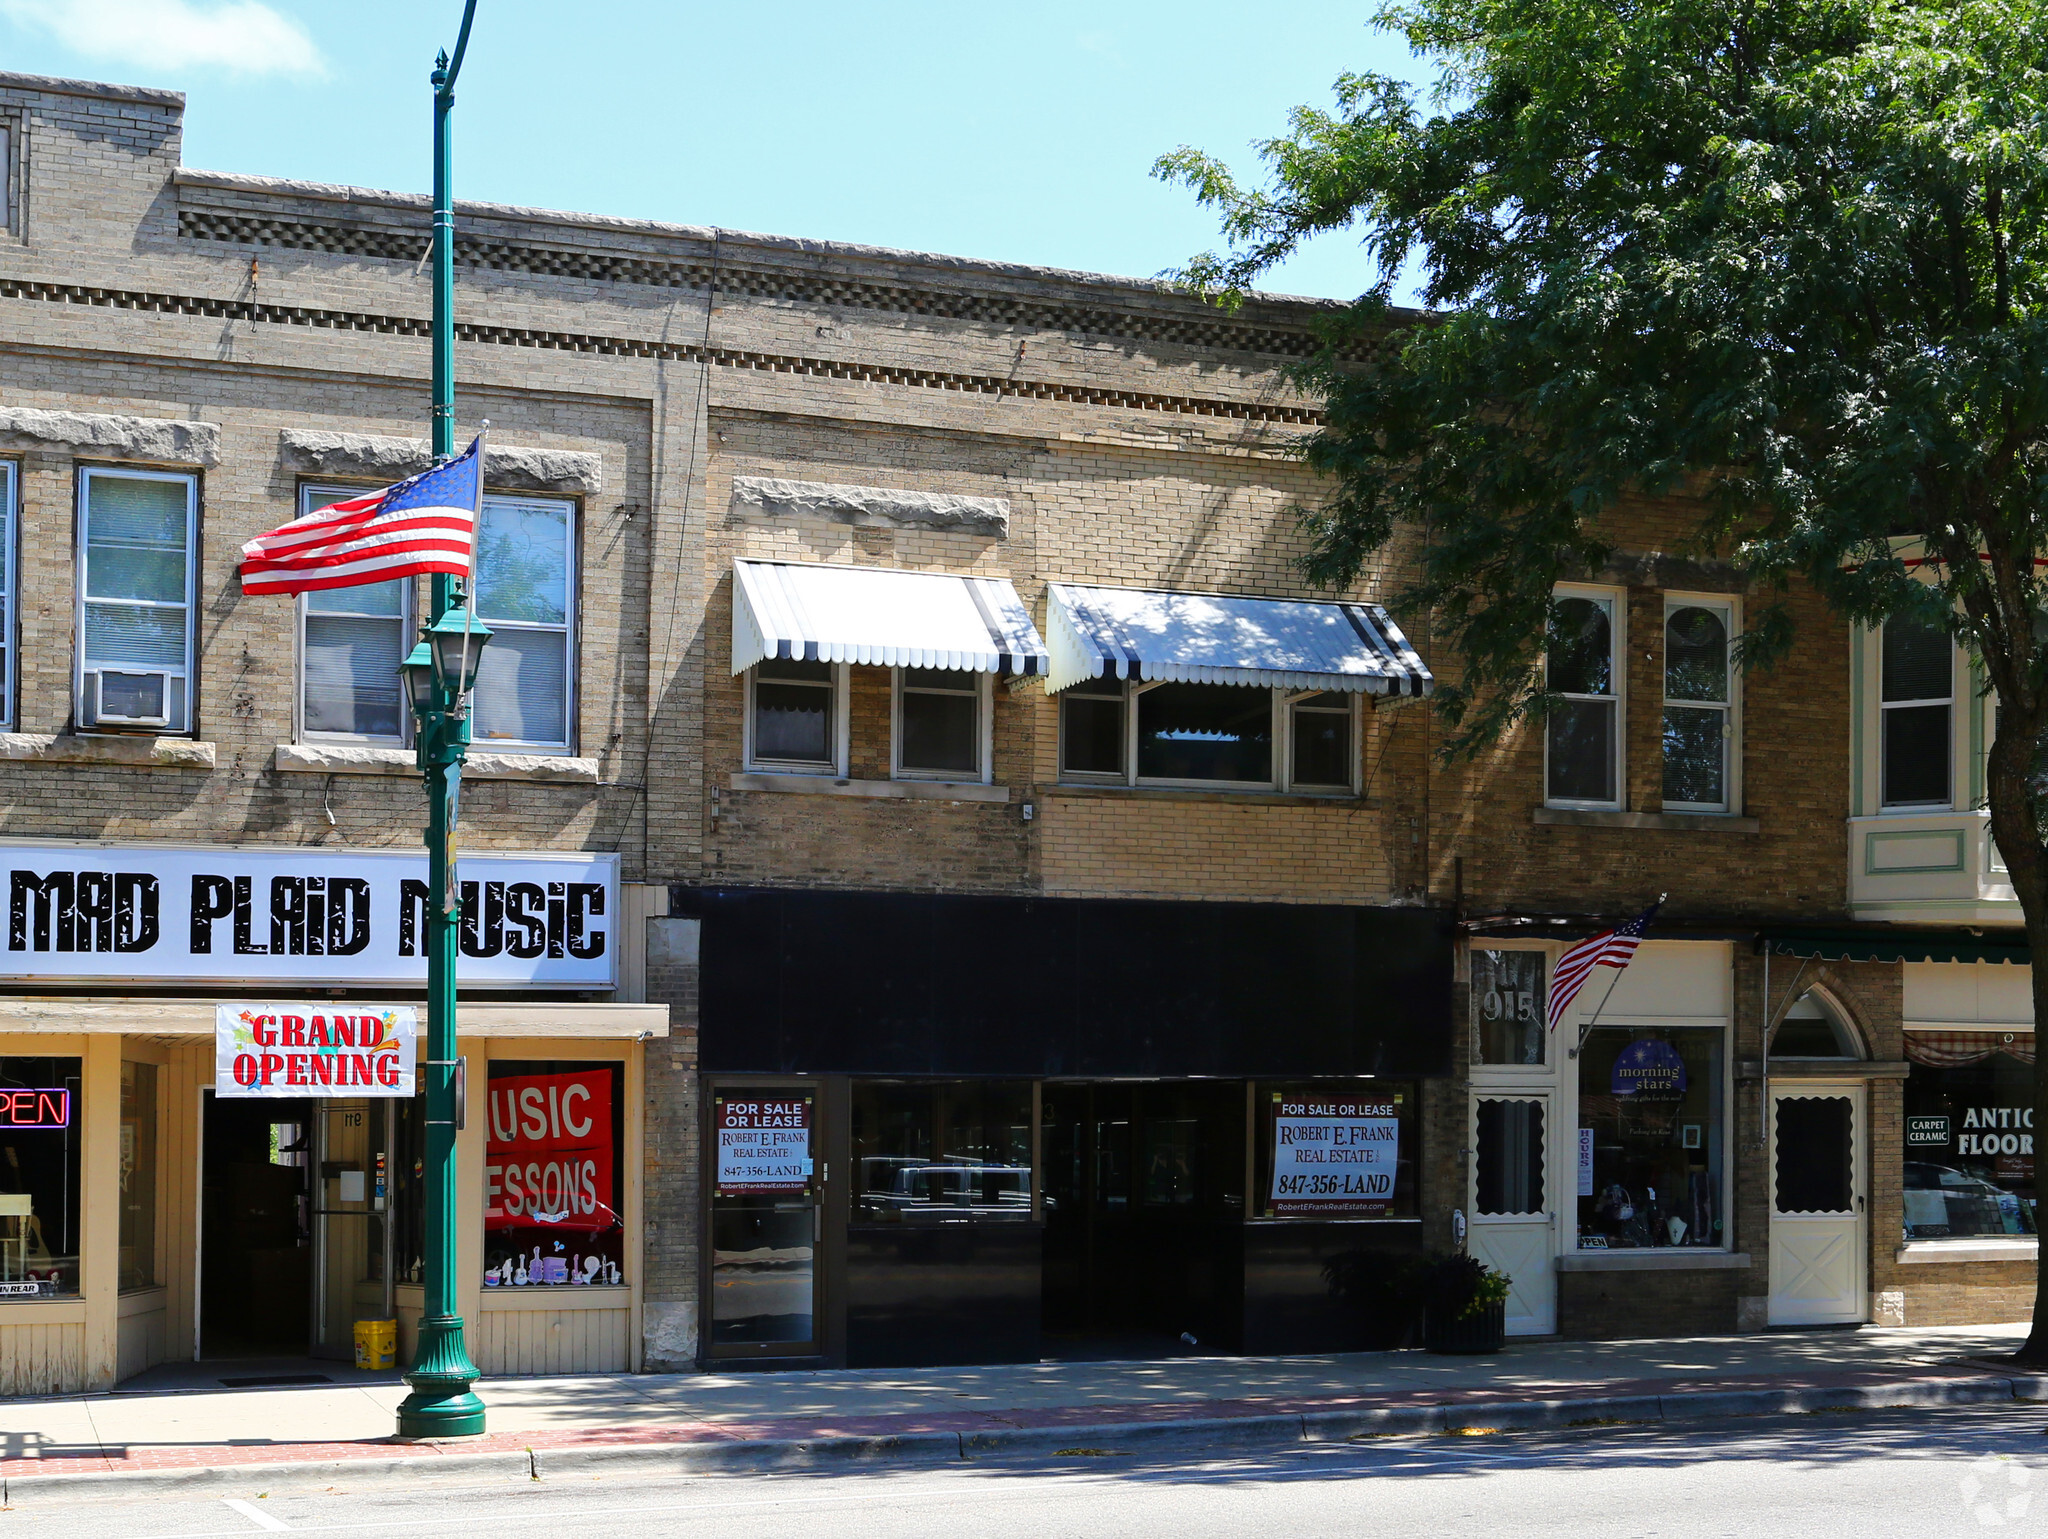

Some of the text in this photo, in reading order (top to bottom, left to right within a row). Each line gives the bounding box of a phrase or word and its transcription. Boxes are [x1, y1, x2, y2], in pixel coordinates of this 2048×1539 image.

[9, 870, 160, 953] MAD
[1483, 990, 1536, 1022] 915
[253, 1014, 386, 1047] GRAND
[233, 1054, 401, 1086] OPENING
[1619, 1064, 1681, 1081] morning
[1636, 1078, 1672, 1090] stars
[486, 1083, 593, 1142] USIC
[726, 1103, 802, 1115] FOR SALE
[1282, 1104, 1393, 1116] FOR SALE OR LEASE
[725, 1116, 803, 1127] OR LEASE
[1911, 1120, 1945, 1130] CARPET
[722, 1132, 758, 1146] ROBERT
[773, 1132, 806, 1146] FRANK
[1280, 1126, 1395, 1145] ROBERT E. FRANK
[1909, 1132, 1948, 1141] CERAMIC
[1579, 1130, 1590, 1167] HOURS
[1958, 1133, 2034, 1156] FLOOR
[733, 1148, 755, 1157] REAL
[757, 1148, 789, 1158] ESTATE
[1295, 1149, 1374, 1163] REAL ESTATE
[1278, 1203, 1385, 1211] RobertEFrankRealEstate.com
[10, 1285, 35, 1293] REAR
